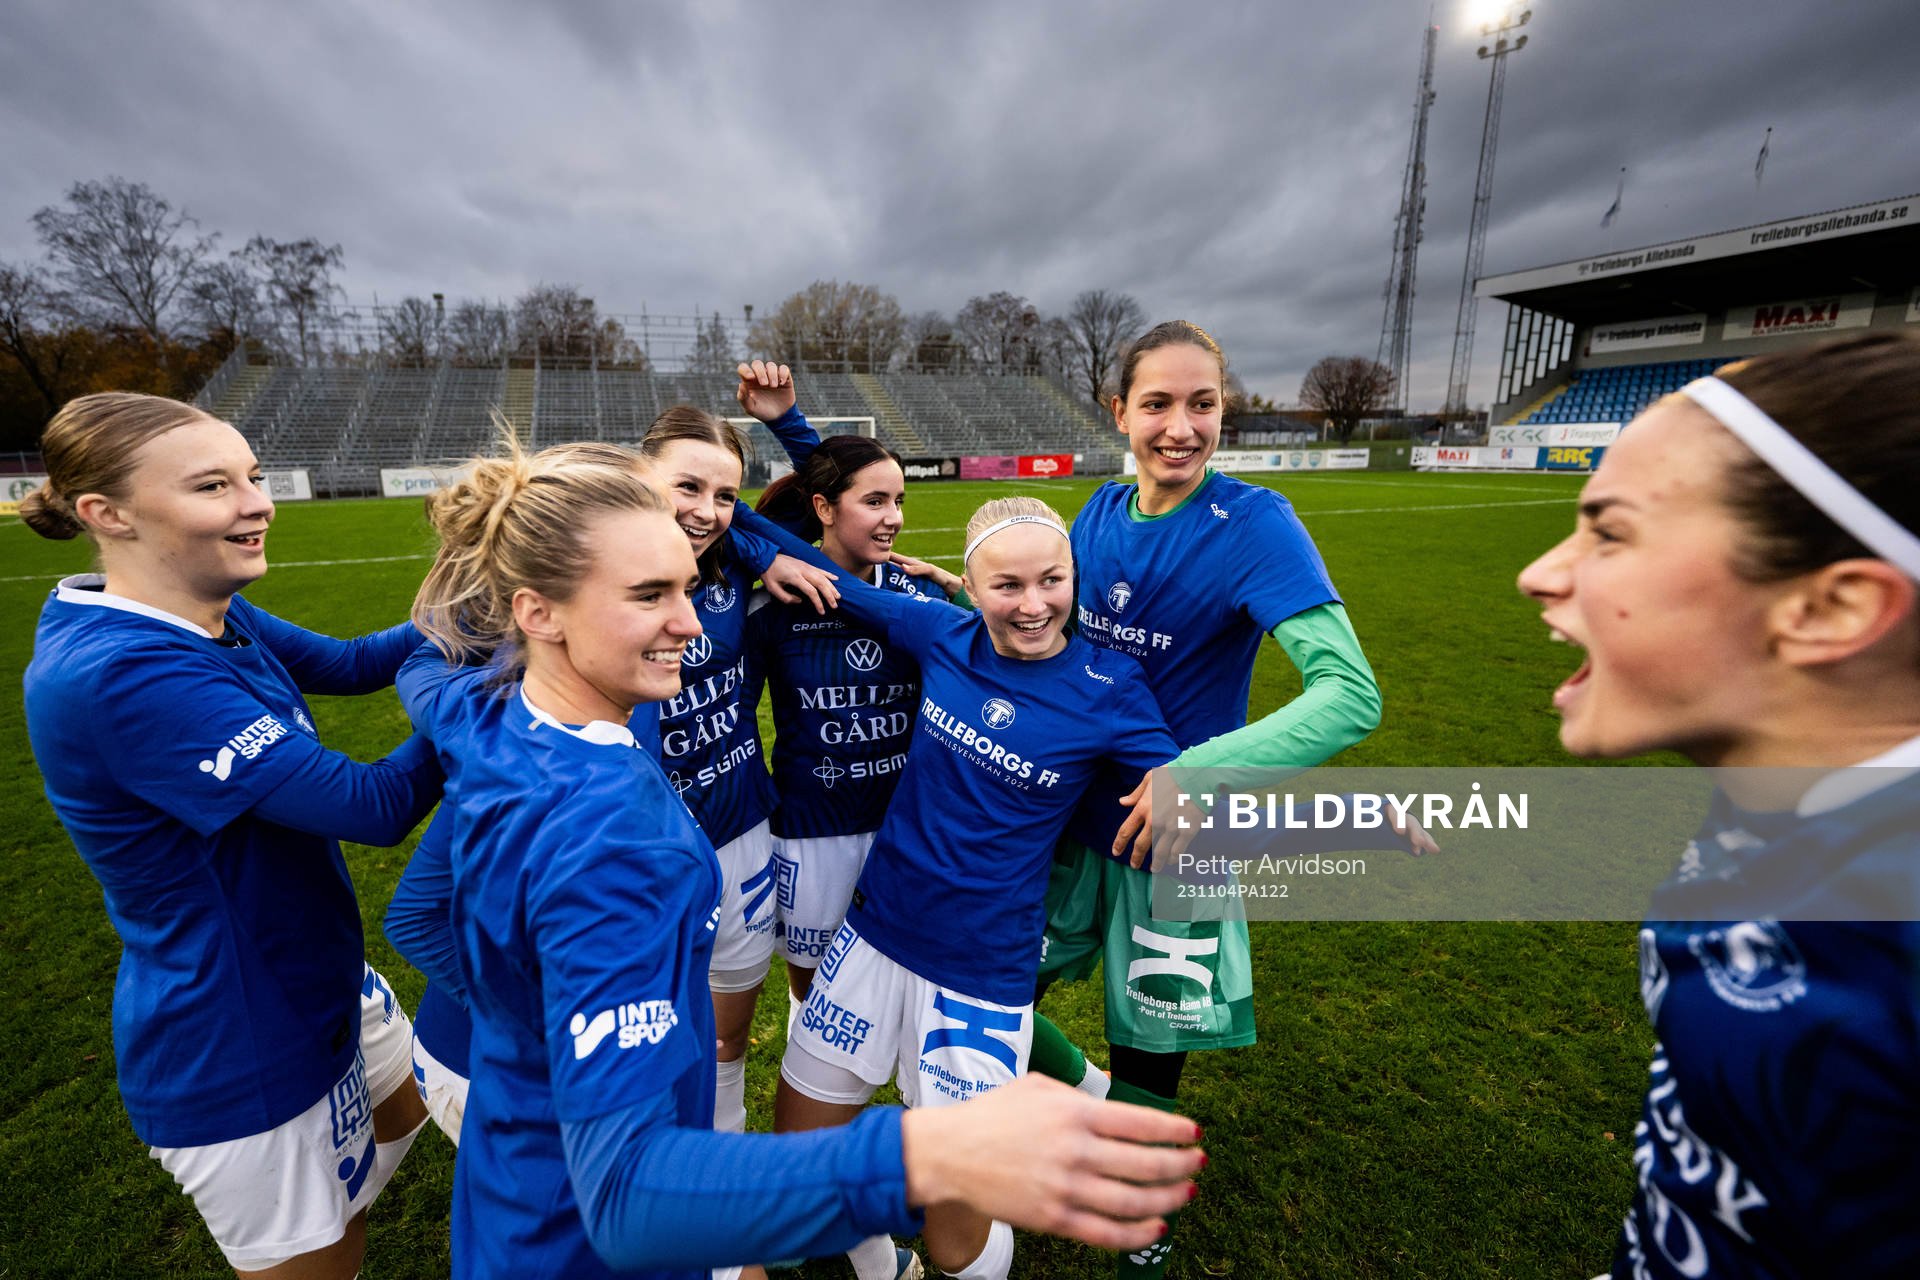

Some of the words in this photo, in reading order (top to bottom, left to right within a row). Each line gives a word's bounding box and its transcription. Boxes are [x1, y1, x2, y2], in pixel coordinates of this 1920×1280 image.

[1750, 205, 1909, 245] trelleborgsallehanda.se
[1591, 253, 1643, 274] Trelleborgs
[1645, 244, 1696, 264] Allehanda
[1753, 302, 1841, 329] MAXI
[792, 621, 833, 632] CRAFT
[1151, 632, 1173, 650] FF
[228, 713, 278, 751] INTER
[240, 722, 288, 760] SPORT
[820, 711, 908, 745] GÅRD
[920, 696, 1034, 779] TRELLEBORGS
[1036, 768, 1061, 789] FF
[850, 752, 907, 779] SIGM
[923, 723, 1001, 778] DAMALLSVENSKAN
[1004, 774, 1030, 792] 2024
[1125, 984, 1178, 1012] Trelleborgs
[809, 989, 870, 1040] INTER
[1157, 1011, 1166, 1019] of
[1169, 1021, 1201, 1031] CRAFT
[802, 1007, 865, 1056] SPORT
[919, 1058, 974, 1091] Trelleborgs
[951, 1089, 960, 1100] of
